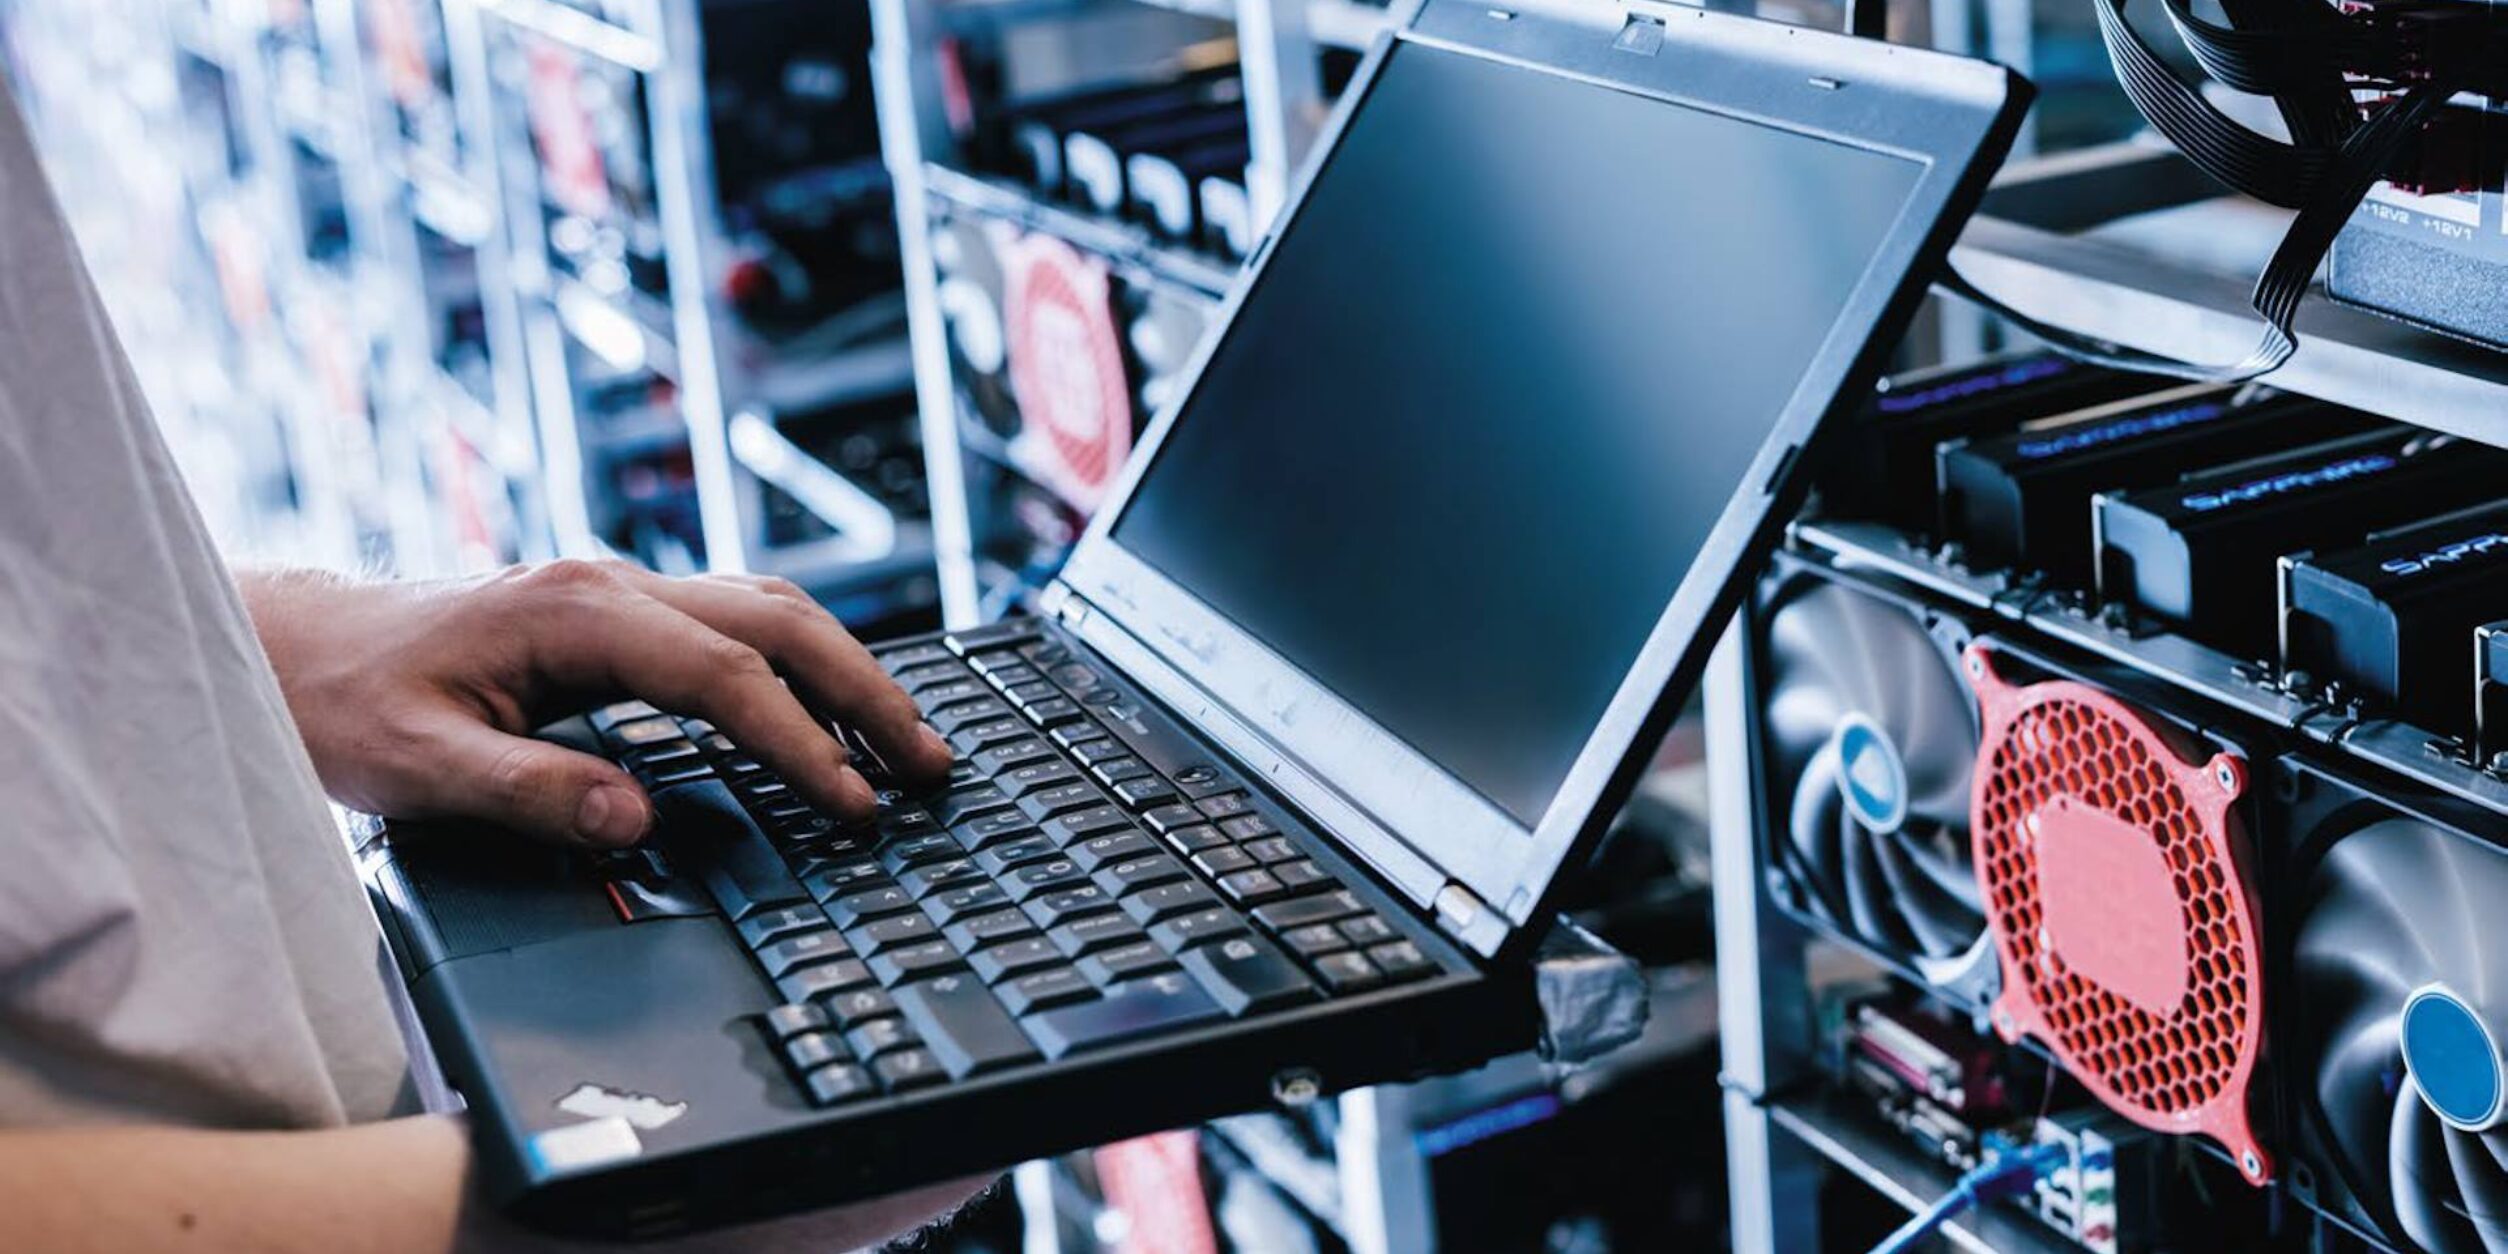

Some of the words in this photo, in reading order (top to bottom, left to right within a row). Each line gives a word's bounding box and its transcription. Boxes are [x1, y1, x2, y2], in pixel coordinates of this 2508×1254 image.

[2361, 203, 2411, 225] +12V2
[2423, 218, 2473, 241] +12V1
[2380, 533, 2508, 577] SAPP
